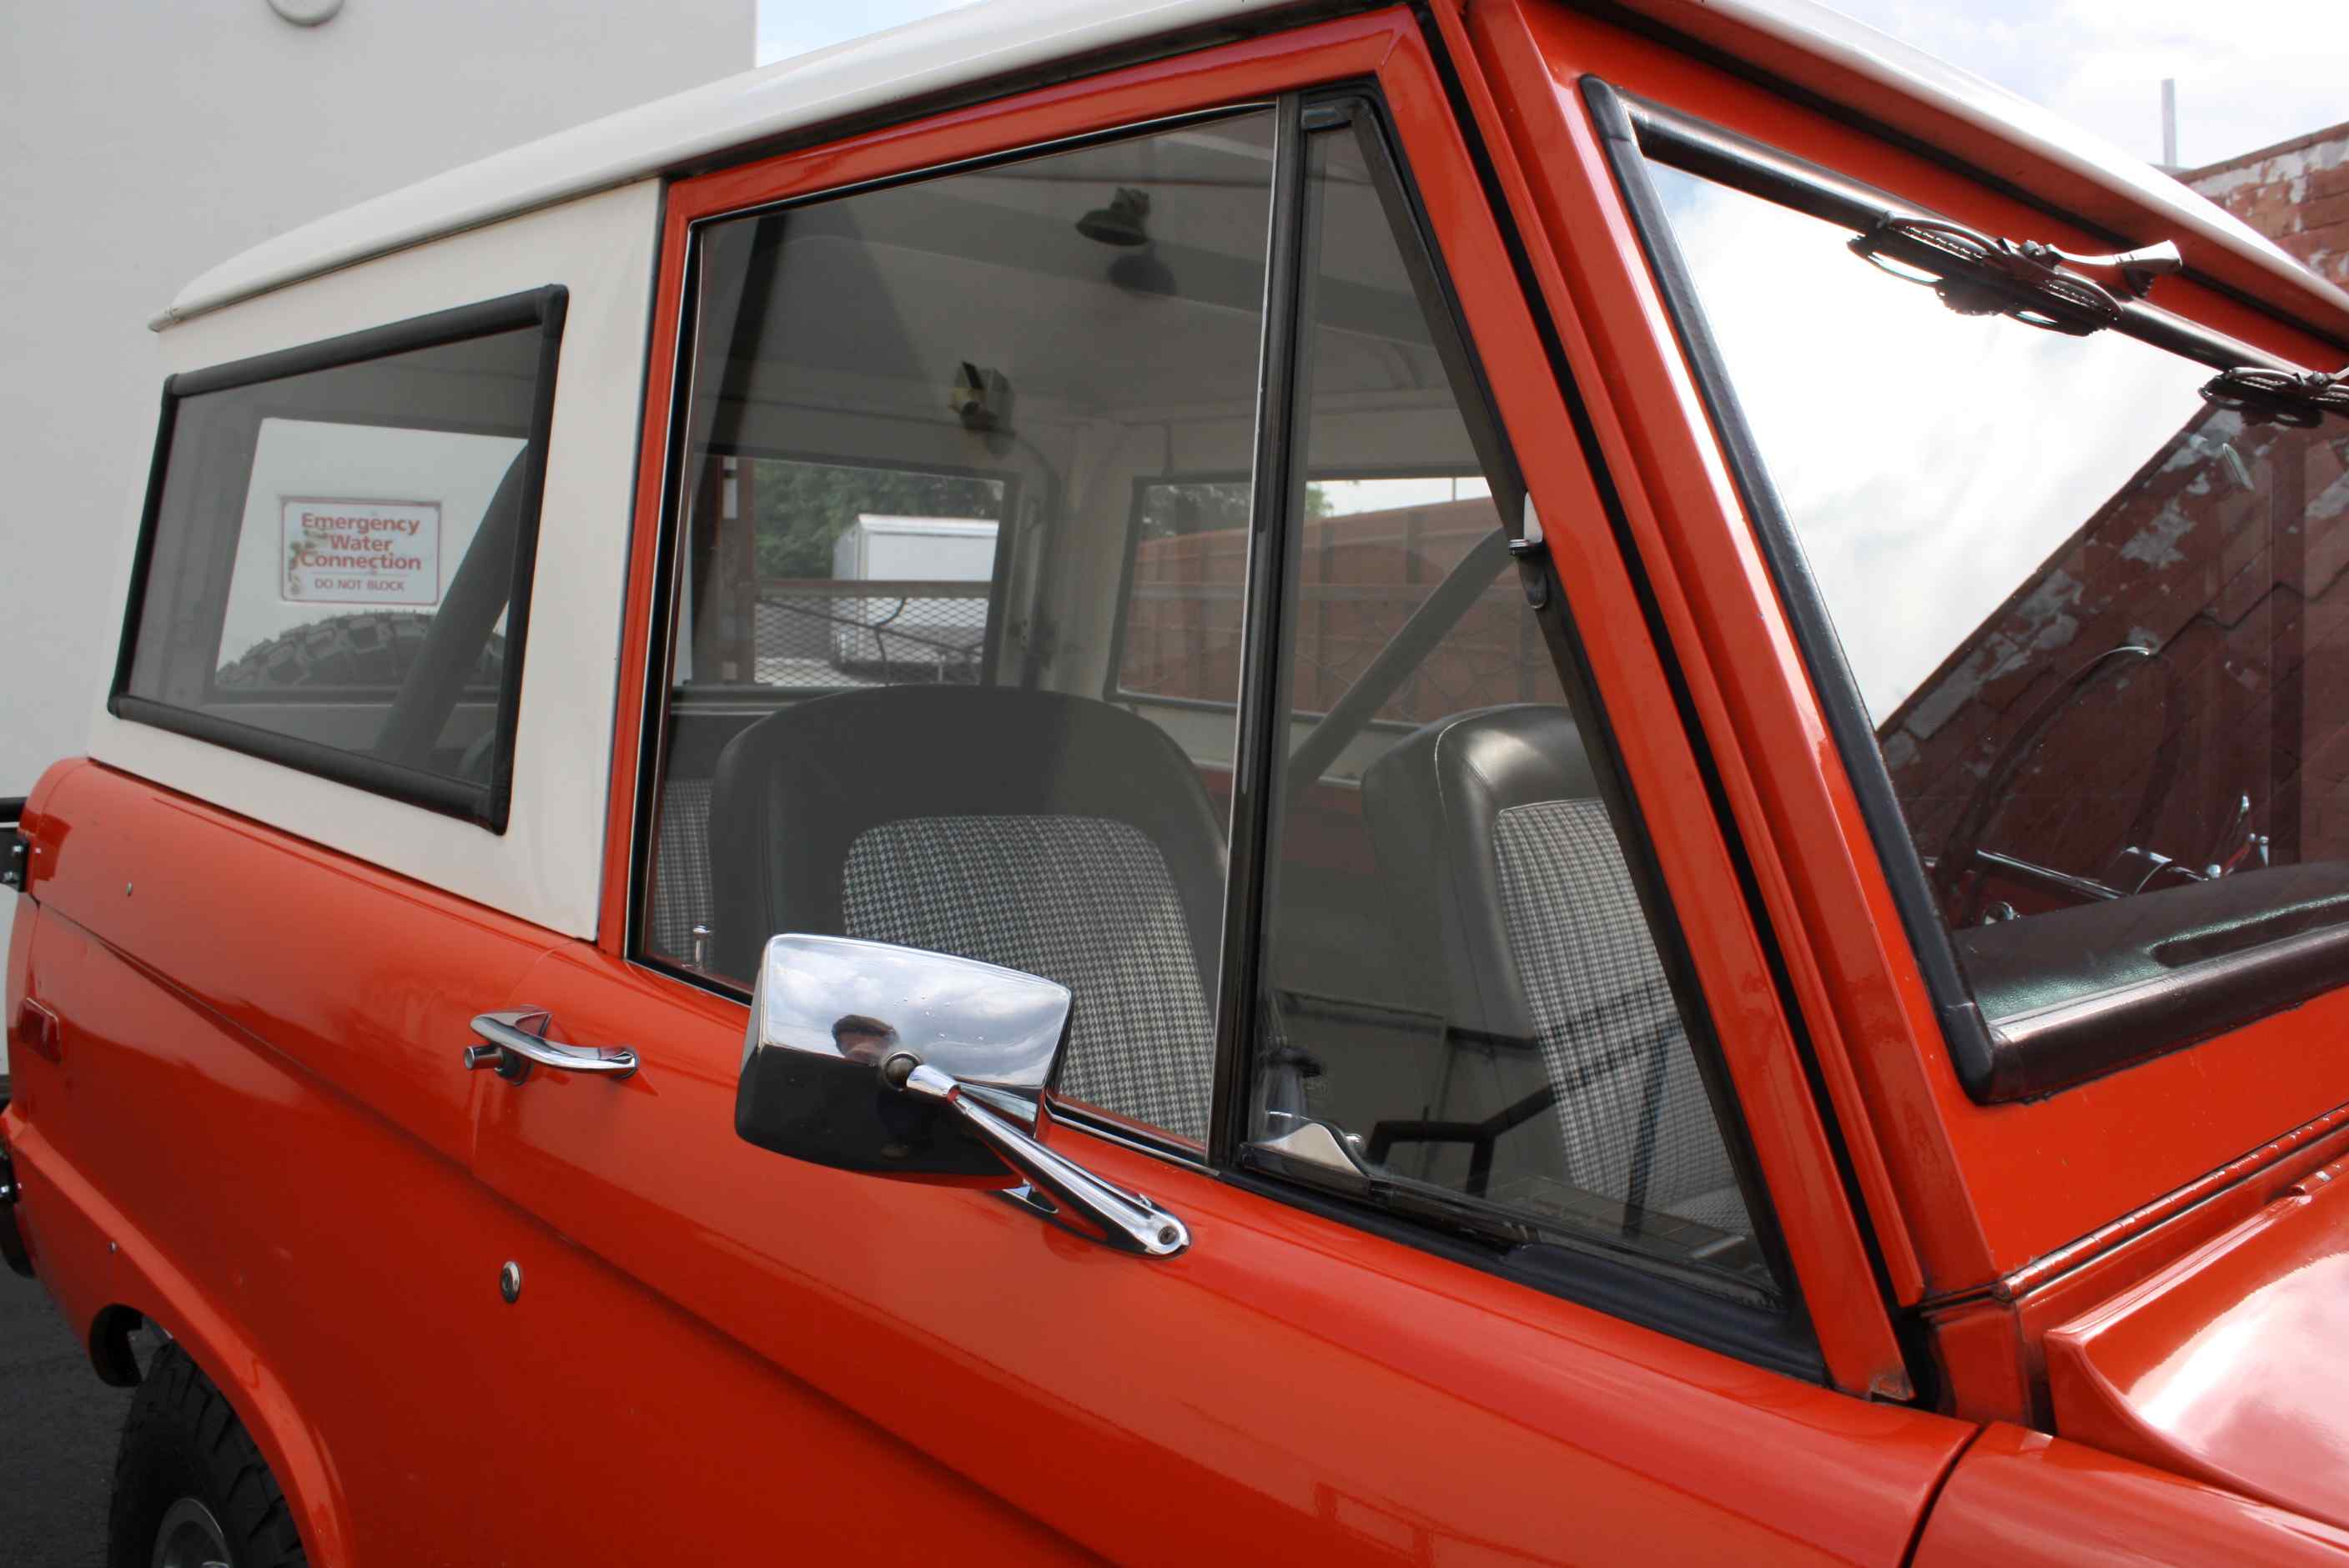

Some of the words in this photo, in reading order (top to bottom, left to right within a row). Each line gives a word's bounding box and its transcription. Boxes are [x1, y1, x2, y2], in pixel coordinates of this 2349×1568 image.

[301, 513, 420, 535] Emergency
[330, 534, 393, 551] Water
[301, 551, 421, 570] Connection
[314, 578, 334, 590] DO
[337, 579, 363, 590] NOT
[367, 580, 405, 591] BLOCK
